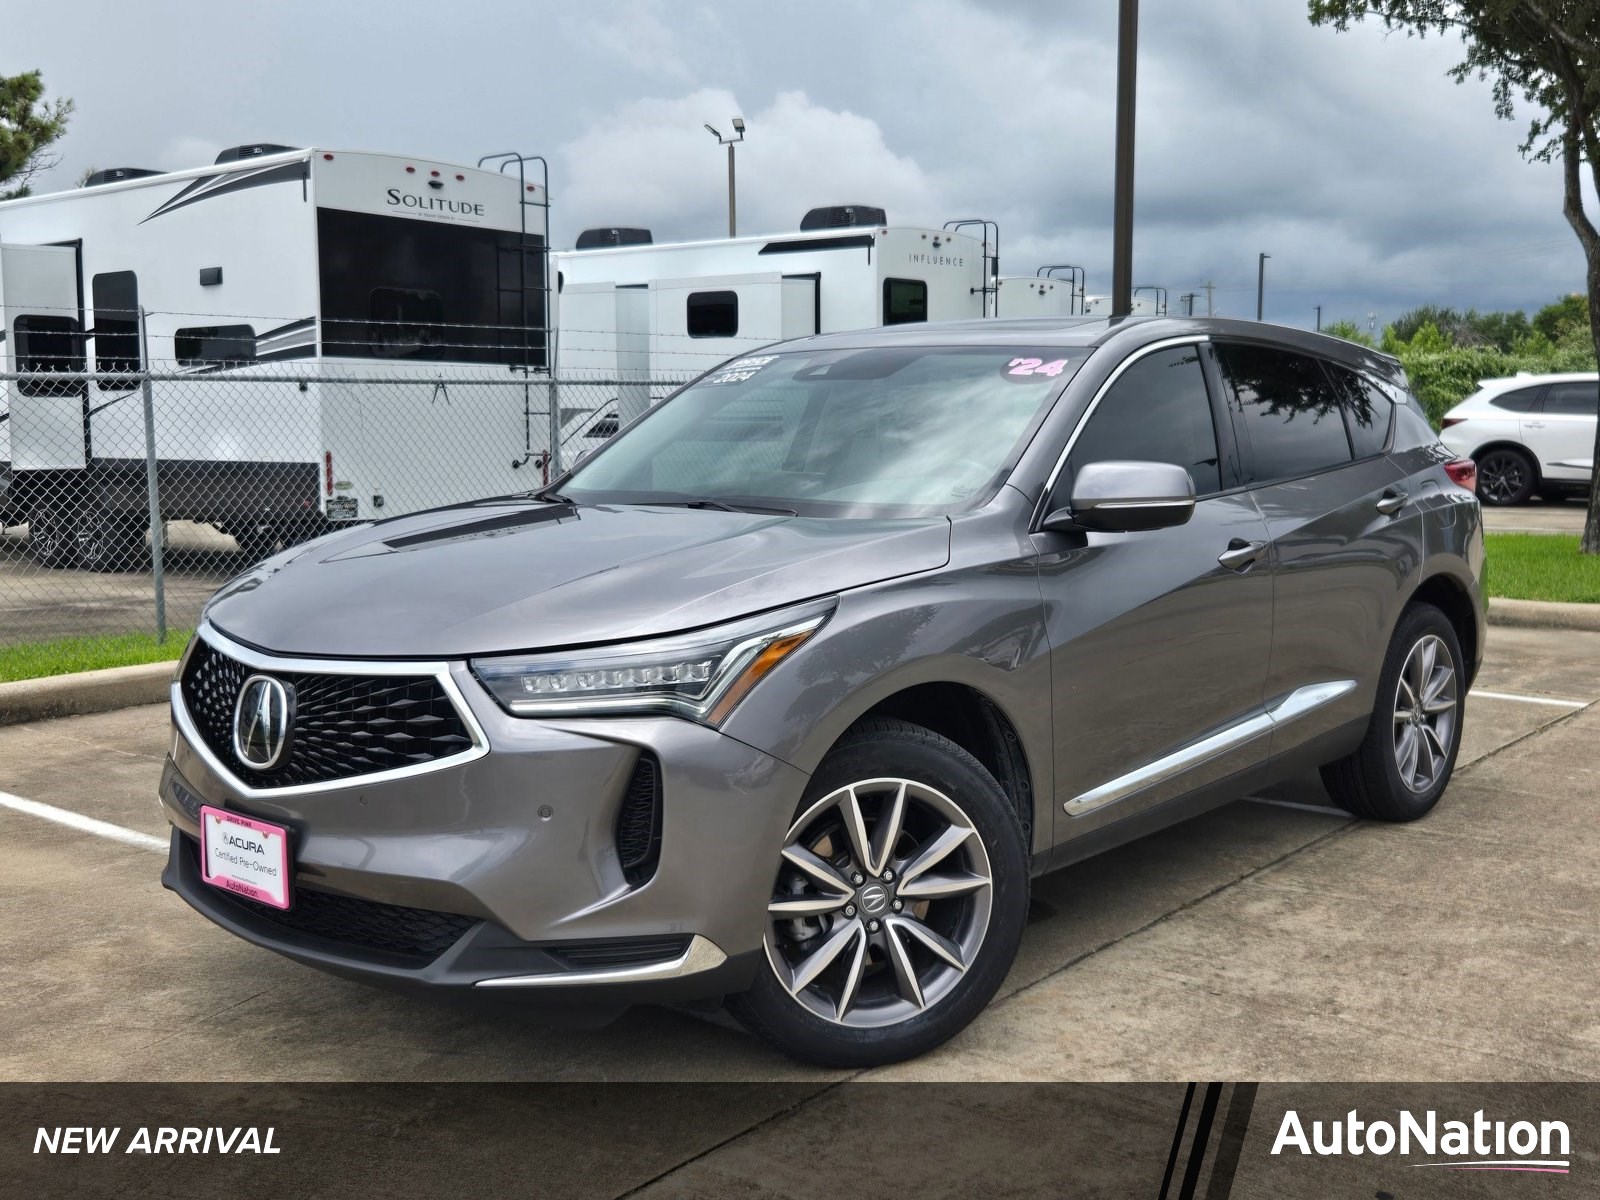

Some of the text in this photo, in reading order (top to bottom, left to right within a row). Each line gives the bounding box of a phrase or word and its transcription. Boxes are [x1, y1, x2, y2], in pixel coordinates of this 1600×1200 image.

[387, 188, 484, 216] SOLITUDE
[909, 252, 964, 267] INFLUENCE
[1008, 358, 1069, 376] '24
[226, 815, 252, 828] DRIVE PINK
[229, 835, 265, 855] ACURA
[214, 847, 277, 876] Certified Pre-Owned
[226, 880, 258, 898] AutoNation
